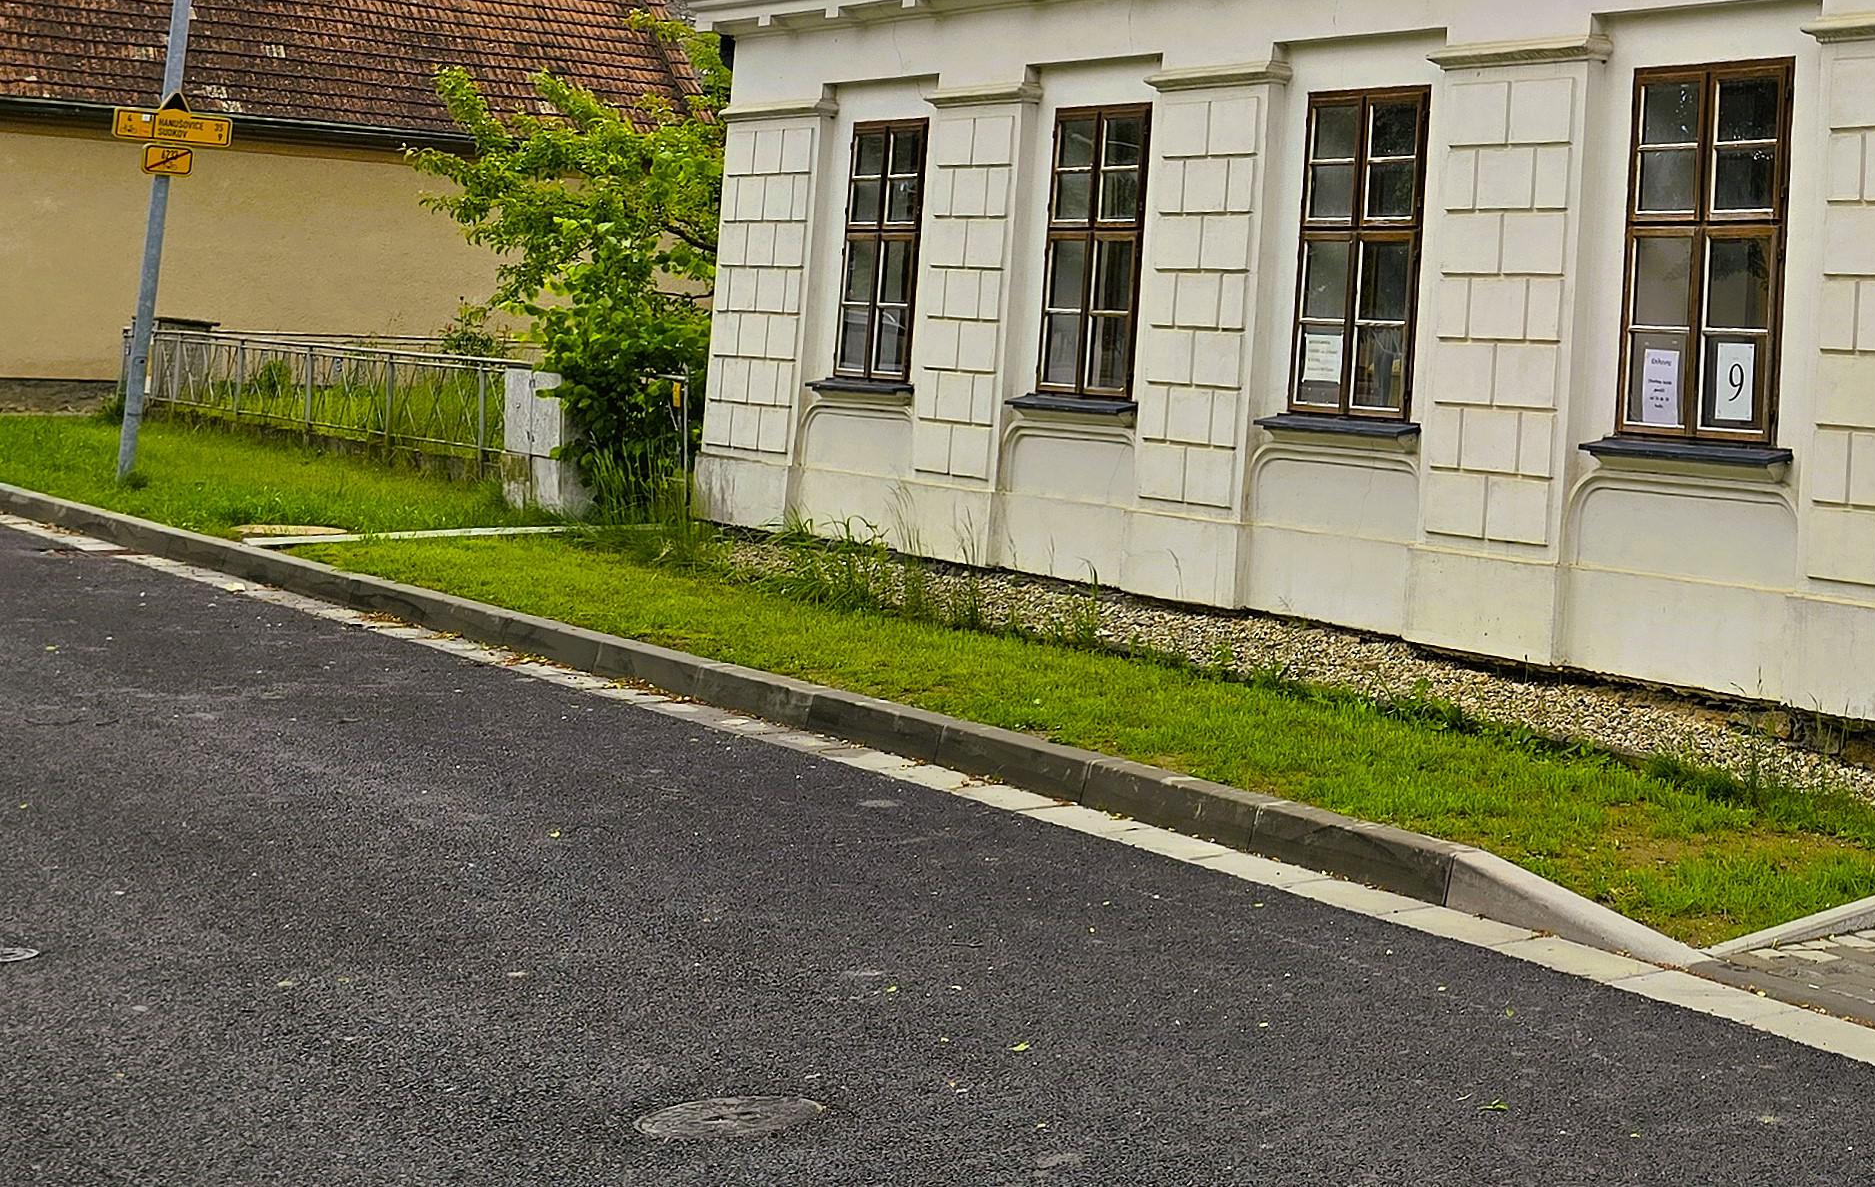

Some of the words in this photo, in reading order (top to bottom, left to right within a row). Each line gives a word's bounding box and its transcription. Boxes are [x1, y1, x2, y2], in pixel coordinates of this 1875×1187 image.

[214, 123, 224, 132] 35
[218, 133, 223, 141] 9
[1729, 363, 1744, 402] 9
